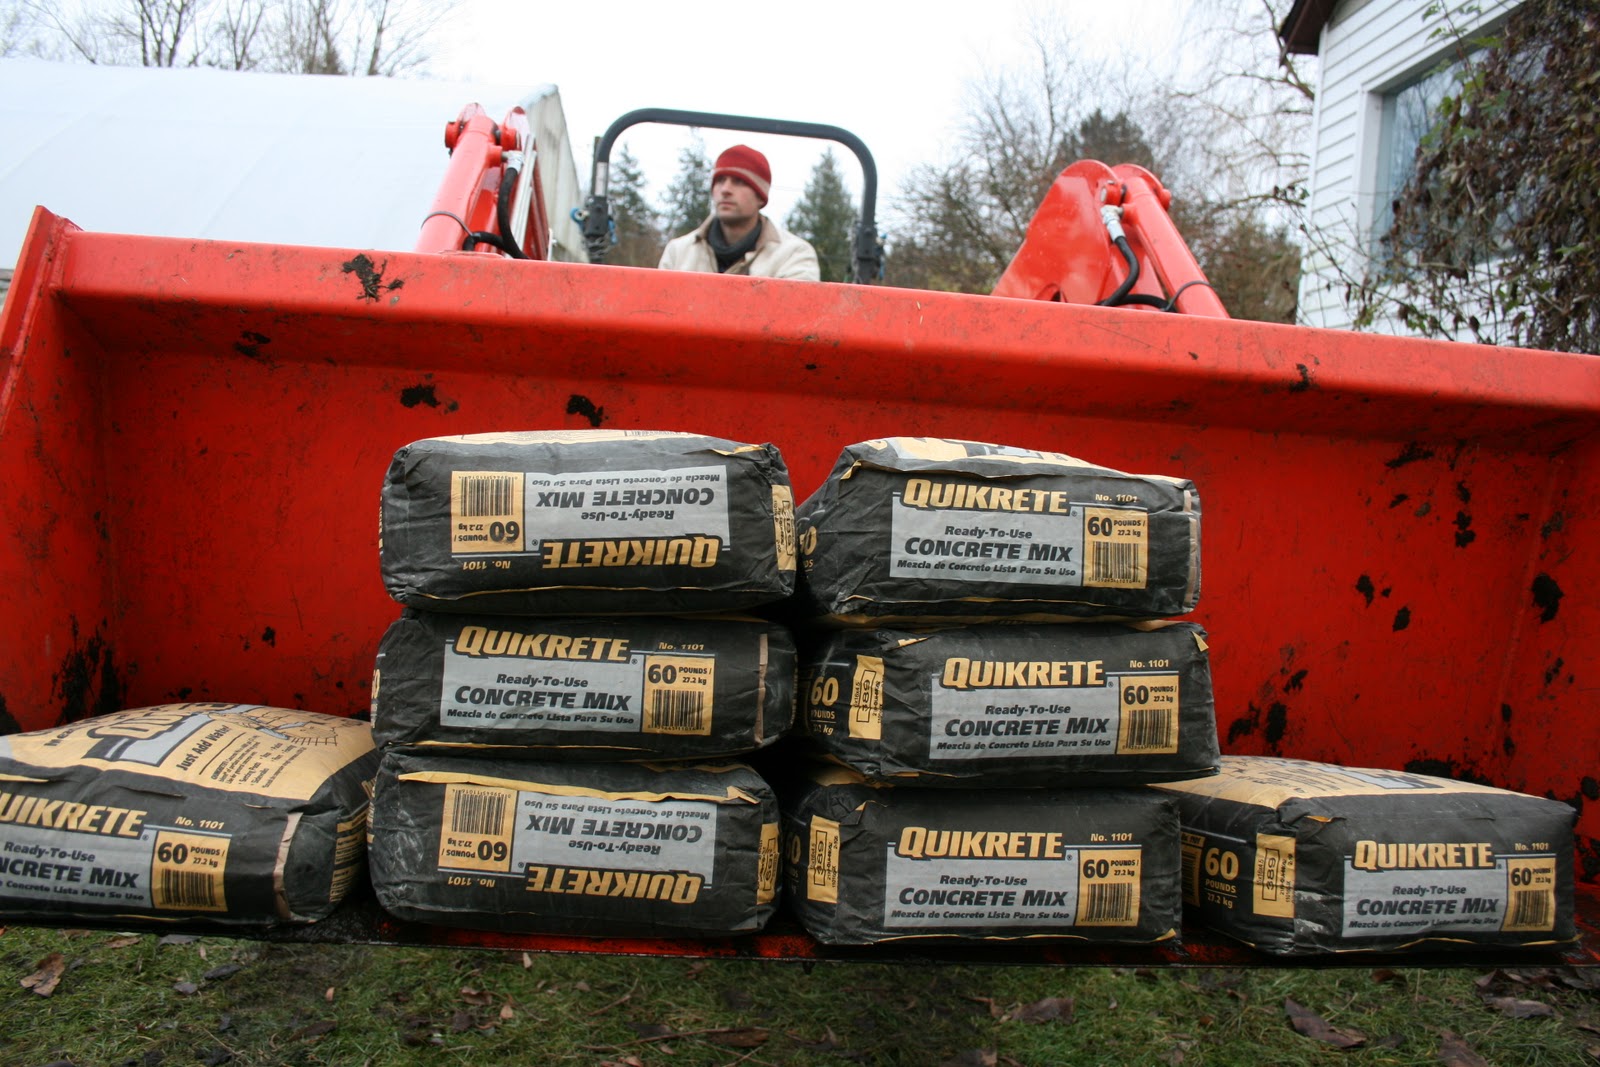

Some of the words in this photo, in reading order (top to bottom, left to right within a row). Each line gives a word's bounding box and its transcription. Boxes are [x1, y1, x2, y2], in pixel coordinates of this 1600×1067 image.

[536, 491, 585, 508] MIX
[592, 487, 715, 506] CONCRETE
[903, 478, 1068, 513] QUIKRETE
[1095, 493, 1112, 501] No.
[1115, 494, 1138, 503] 1101
[581, 509, 675, 521] Ready-To-Use
[1113, 519, 1142, 527] POUNDS
[489, 521, 520, 542] 60
[944, 525, 1033, 539] Ready-To-Use
[1087, 516, 1113, 536] 60
[542, 537, 720, 569] QUIKRETE
[904, 537, 1021, 559] CONCRETE
[1028, 543, 1073, 562] MIX
[463, 561, 487, 570] 1101
[492, 560, 511, 569] No.
[456, 626, 629, 661] QUIKRETE
[658, 642, 676, 650] No.
[681, 643, 704, 651] 1101
[678, 666, 708, 674] POUNDS
[943, 657, 1104, 688] QUIKRETE
[1130, 660, 1146, 668] No.
[1148, 659, 1169, 668] 1101
[496, 674, 588, 687] Ready-To-Use
[648, 664, 677, 684] 60
[455, 686, 576, 708] CONCRETE
[582, 692, 632, 711] MIX
[811, 676, 839, 706] 60
[1123, 685, 1149, 705] 60
[1150, 685, 1174, 693] POUNDS
[985, 704, 1071, 716] Ready-To-Use
[945, 719, 1060, 736] CONCRETE
[1065, 717, 1110, 734] MIX
[176, 753, 199, 771] Just
[191, 739, 213, 755] Add
[0, 791, 147, 836] UIKRETE
[175, 816, 194, 826] No.
[199, 819, 224, 829] 1101
[525, 814, 575, 835] MIX
[581, 818, 702, 843] CONCRETE
[898, 826, 1063, 858] QUIKRETE
[1090, 833, 1107, 841] No.
[1111, 833, 1132, 841] 1101
[1515, 843, 1529, 851] No.
[1532, 842, 1549, 851] 1101
[4, 841, 96, 862] Ready-To-Use
[158, 842, 188, 864] 60
[190, 846, 220, 856] POUNDS
[446, 849, 475, 858] POUNDS
[478, 840, 508, 861] 60
[568, 839, 661, 855] Ready-To-Use
[1354, 840, 1494, 870] QUIKRETE
[0, 856, 83, 882] NCRETE
[89, 867, 139, 888] MIX
[1083, 859, 1109, 878] 60
[1205, 847, 1239, 880] 60
[448, 876, 471, 886] 1101
[477, 878, 495, 888] No.
[940, 875, 1028, 887] Ready-To-Use
[1266, 857, 1276, 891] 389
[1511, 867, 1532, 886] 60
[526, 865, 701, 904] QUIKRETE
[1205, 879, 1237, 894] POUNDS
[1392, 885, 1467, 896] Ready-To-Use
[899, 887, 1016, 906] CONCRETE
[1022, 890, 1068, 906] MIX
[1222, 896, 1233, 909] kg
[1356, 899, 1457, 915] CONCRETE
[1461, 898, 1499, 913] MIX
